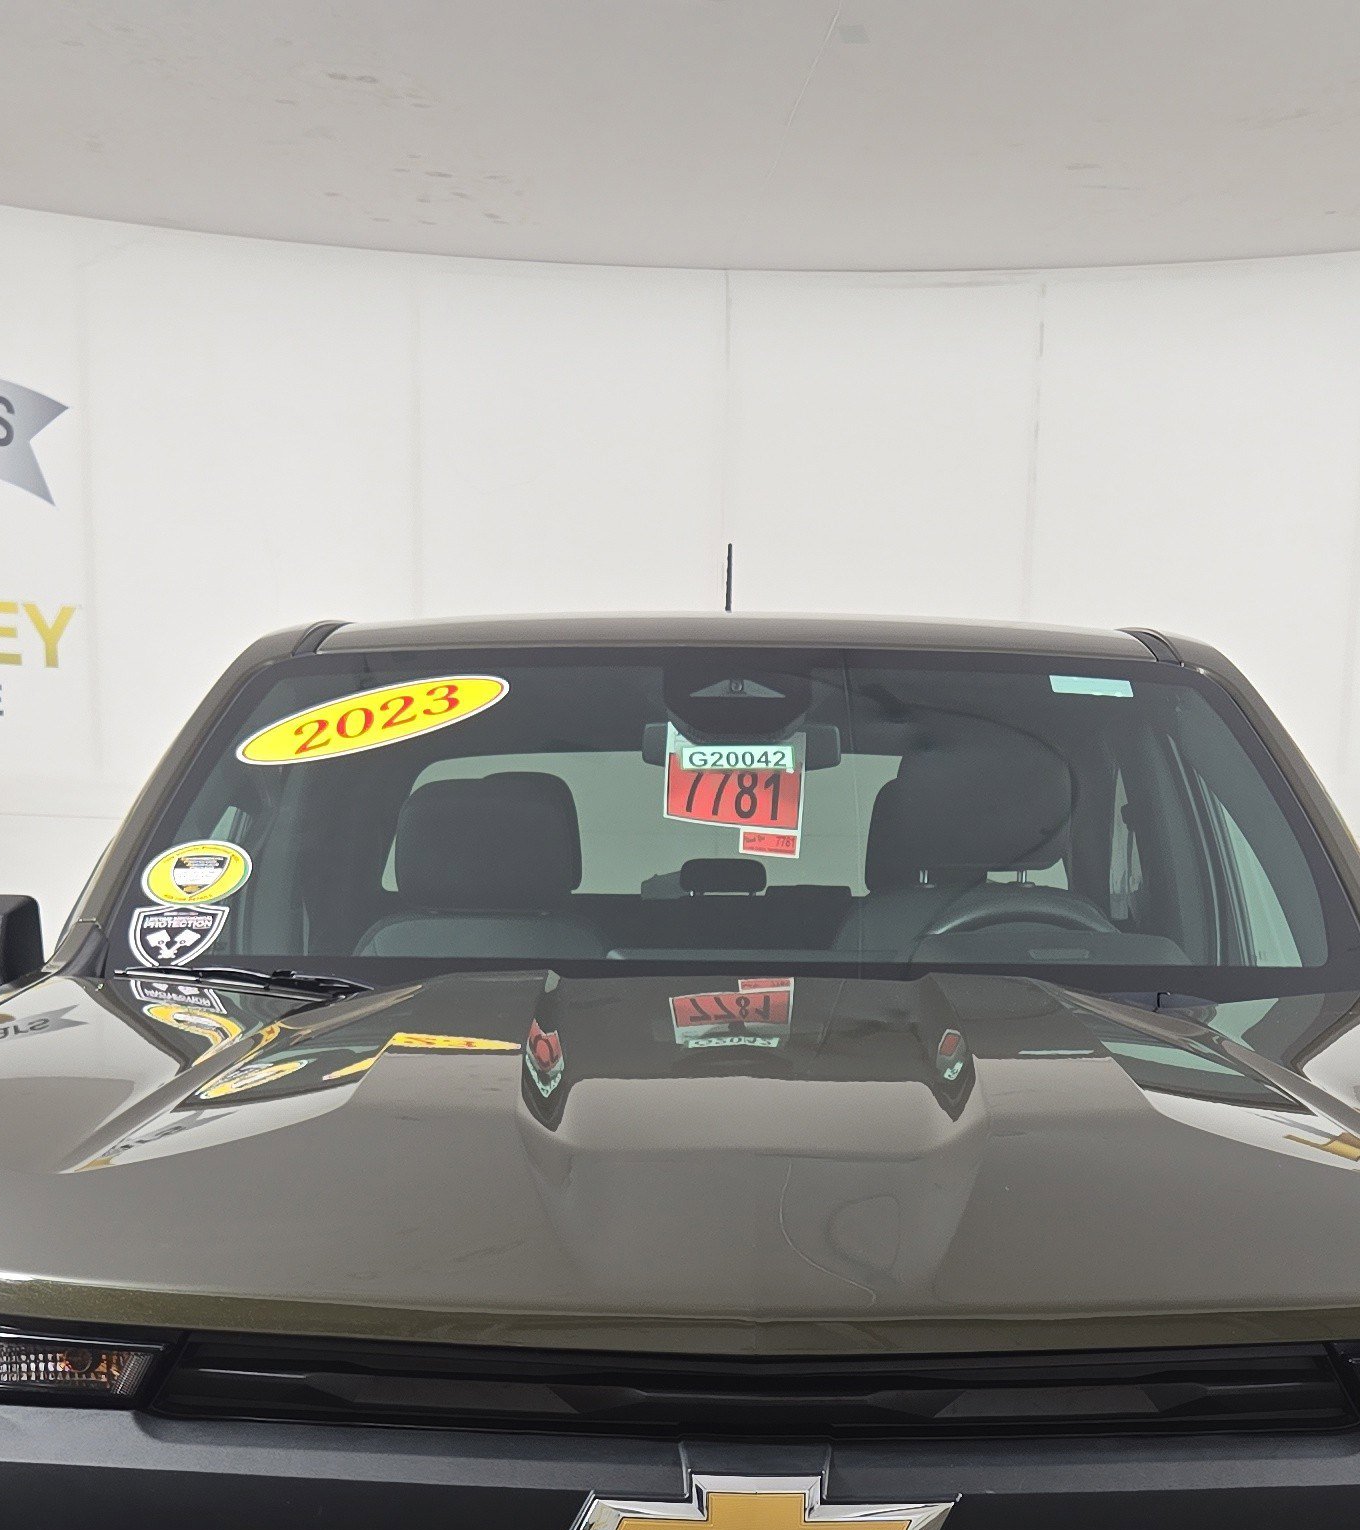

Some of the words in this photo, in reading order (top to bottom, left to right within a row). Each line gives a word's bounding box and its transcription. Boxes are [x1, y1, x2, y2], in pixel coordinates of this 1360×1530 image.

[294, 684, 460, 755] 2023
[688, 750, 787, 768] G20042
[685, 771, 782, 821] 7781
